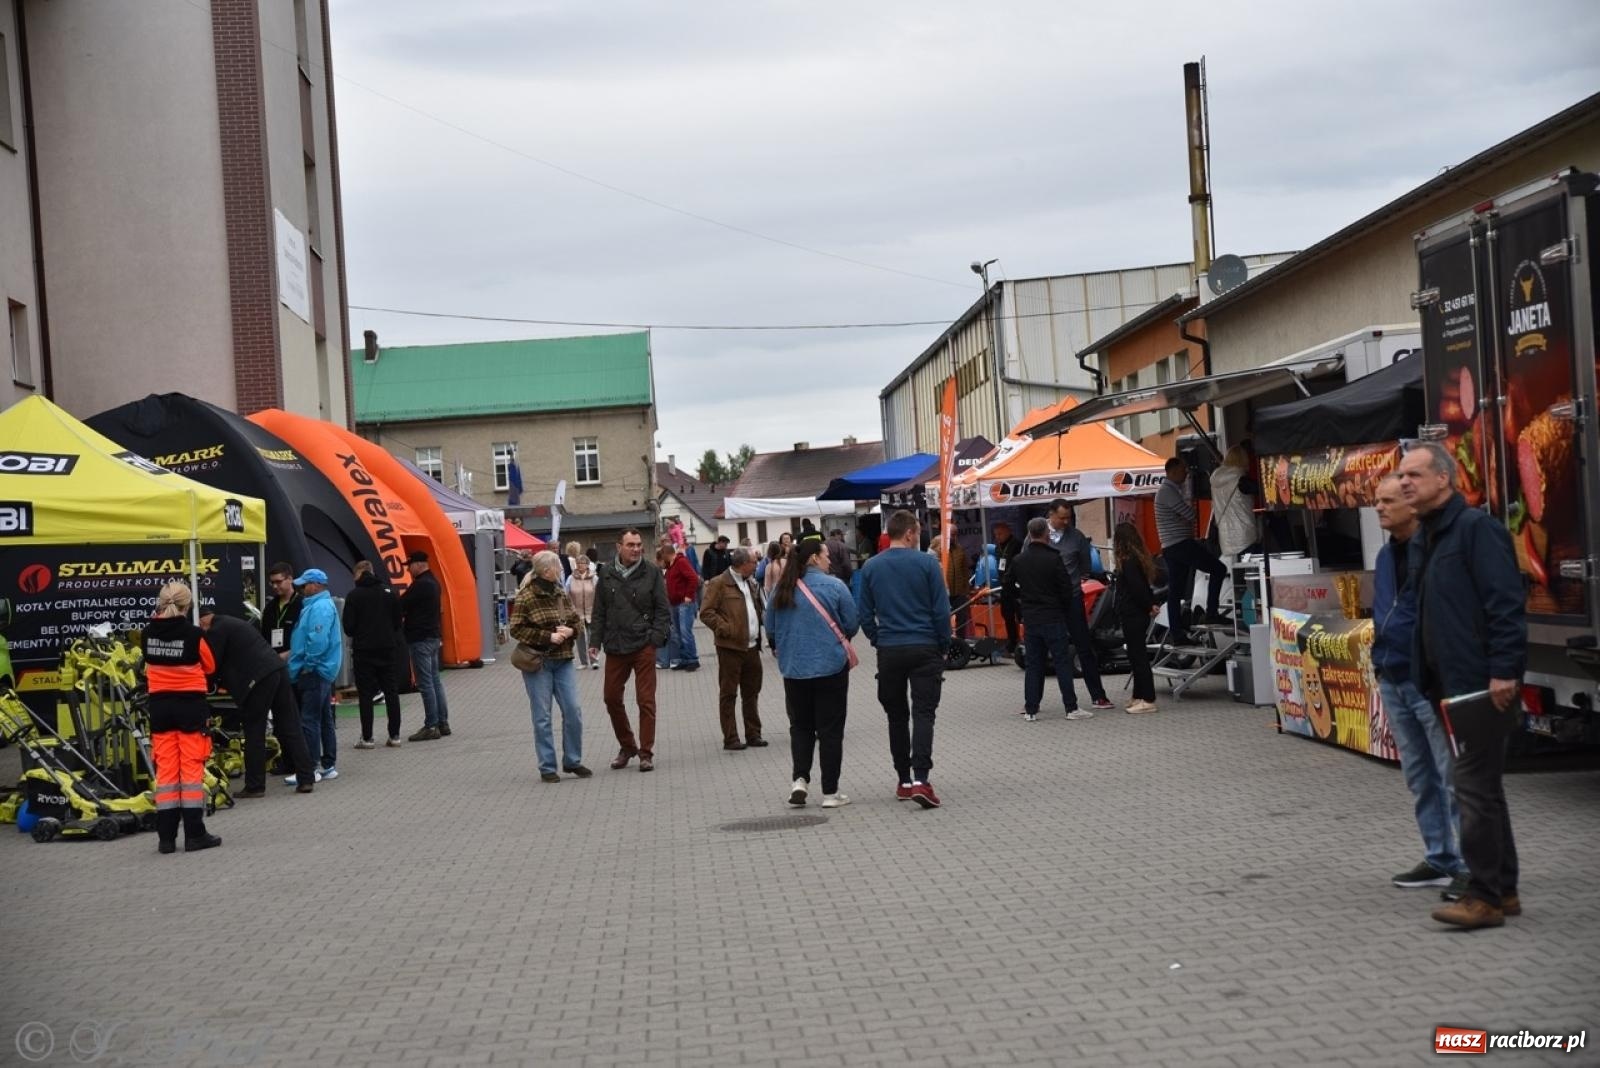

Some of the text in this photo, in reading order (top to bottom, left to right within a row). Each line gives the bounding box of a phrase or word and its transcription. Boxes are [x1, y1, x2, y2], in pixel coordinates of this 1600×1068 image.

[1508, 301, 1552, 335] JANETA
[0, 455, 69, 473] OBI
[154, 444, 225, 466] MARK
[1012, 479, 1080, 498] Oleo-Mac
[0, 507, 29, 531] BI
[58, 578, 132, 589] PRODUCENT
[54, 597, 136, 610] CENTRALNEGO
[71, 610, 117, 621] BUFORY
[8, 640, 53, 650] EMENTY
